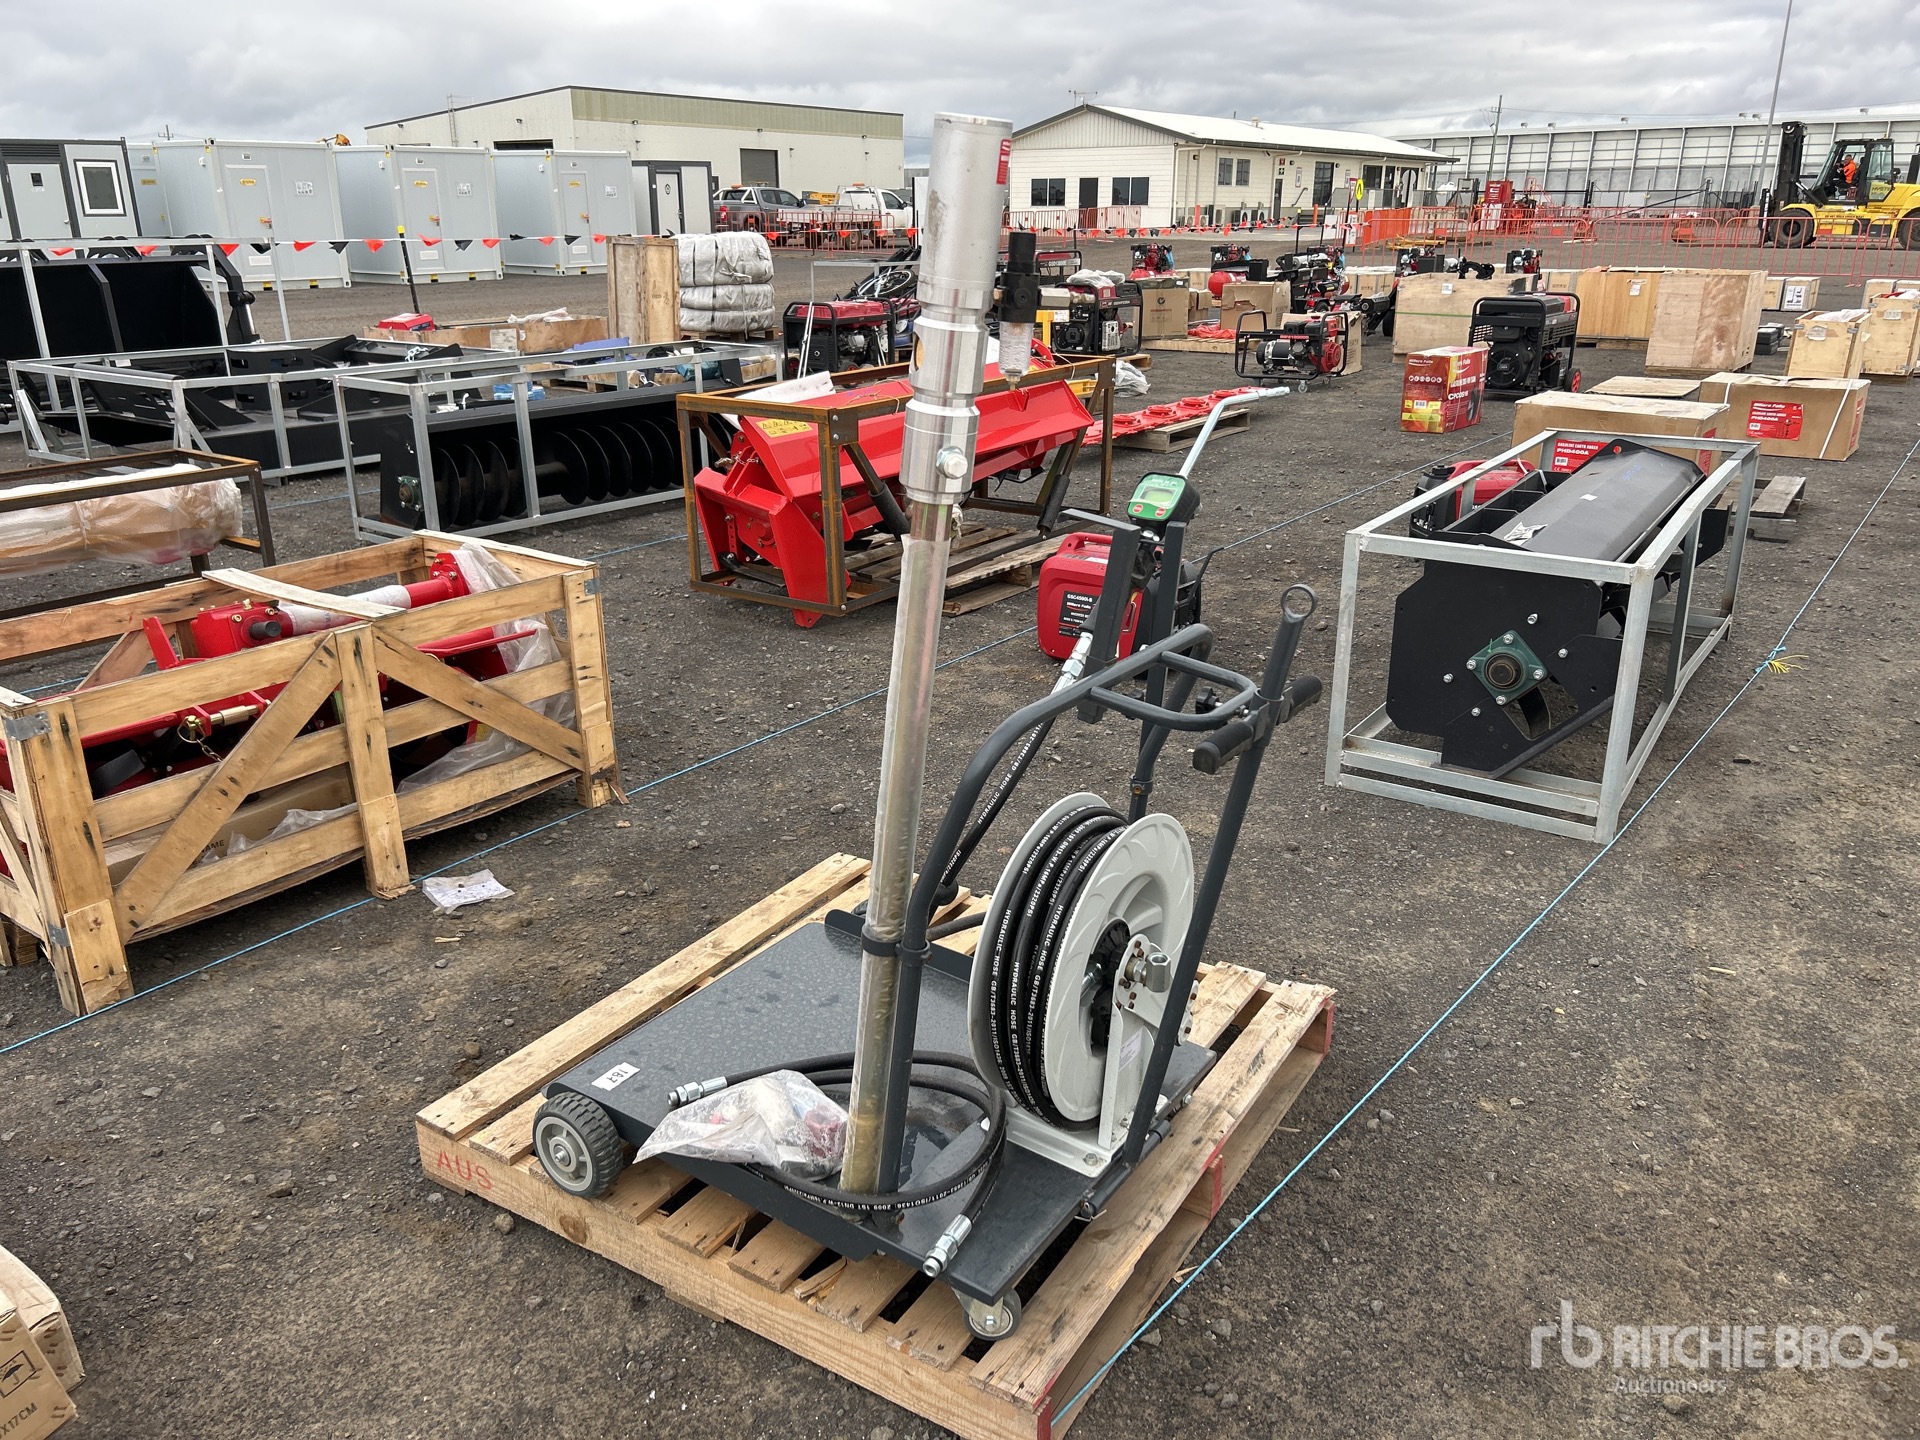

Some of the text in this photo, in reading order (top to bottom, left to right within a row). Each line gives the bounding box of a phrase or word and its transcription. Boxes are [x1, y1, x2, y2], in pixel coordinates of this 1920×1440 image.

[977, 791, 1000, 825] HYDRAULIC
[1000, 773, 1012, 790] HOSE
[201, 839, 225, 853] AME
[996, 909, 1012, 952] HYDRAULIC
[1044, 904, 1064, 947] HYDRAULIC
[992, 955, 1000, 976] HOSE
[1037, 949, 1048, 971] HOSE
[1010, 961, 1020, 1006] HYDRAULIC
[437, 1150, 494, 1190] AUS
